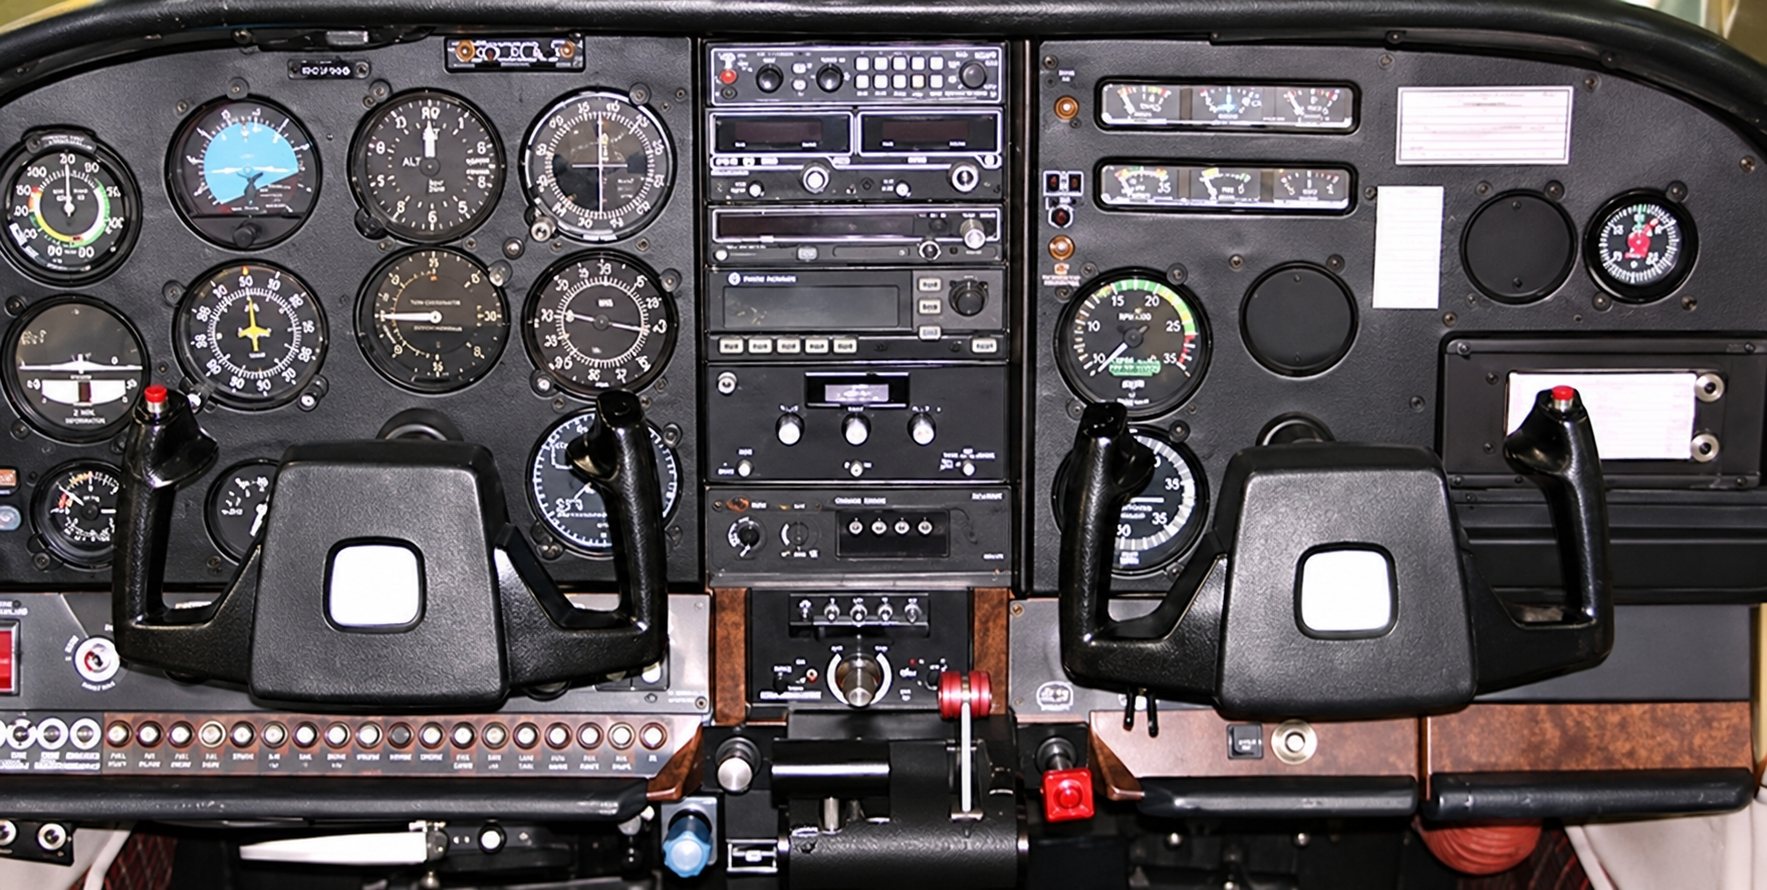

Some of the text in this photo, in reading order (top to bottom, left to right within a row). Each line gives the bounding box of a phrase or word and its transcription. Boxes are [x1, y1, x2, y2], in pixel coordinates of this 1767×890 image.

[402, 157, 421, 167] ALT
[1112, 296, 1125, 307] 15
[1144, 296, 1160, 307] 20
[1088, 321, 1101, 332] 10
[1166, 320, 1181, 332] 25
[1163, 353, 1177, 364] 35
[1164, 478, 1180, 490] 35
[1151, 512, 1167, 525] 35
